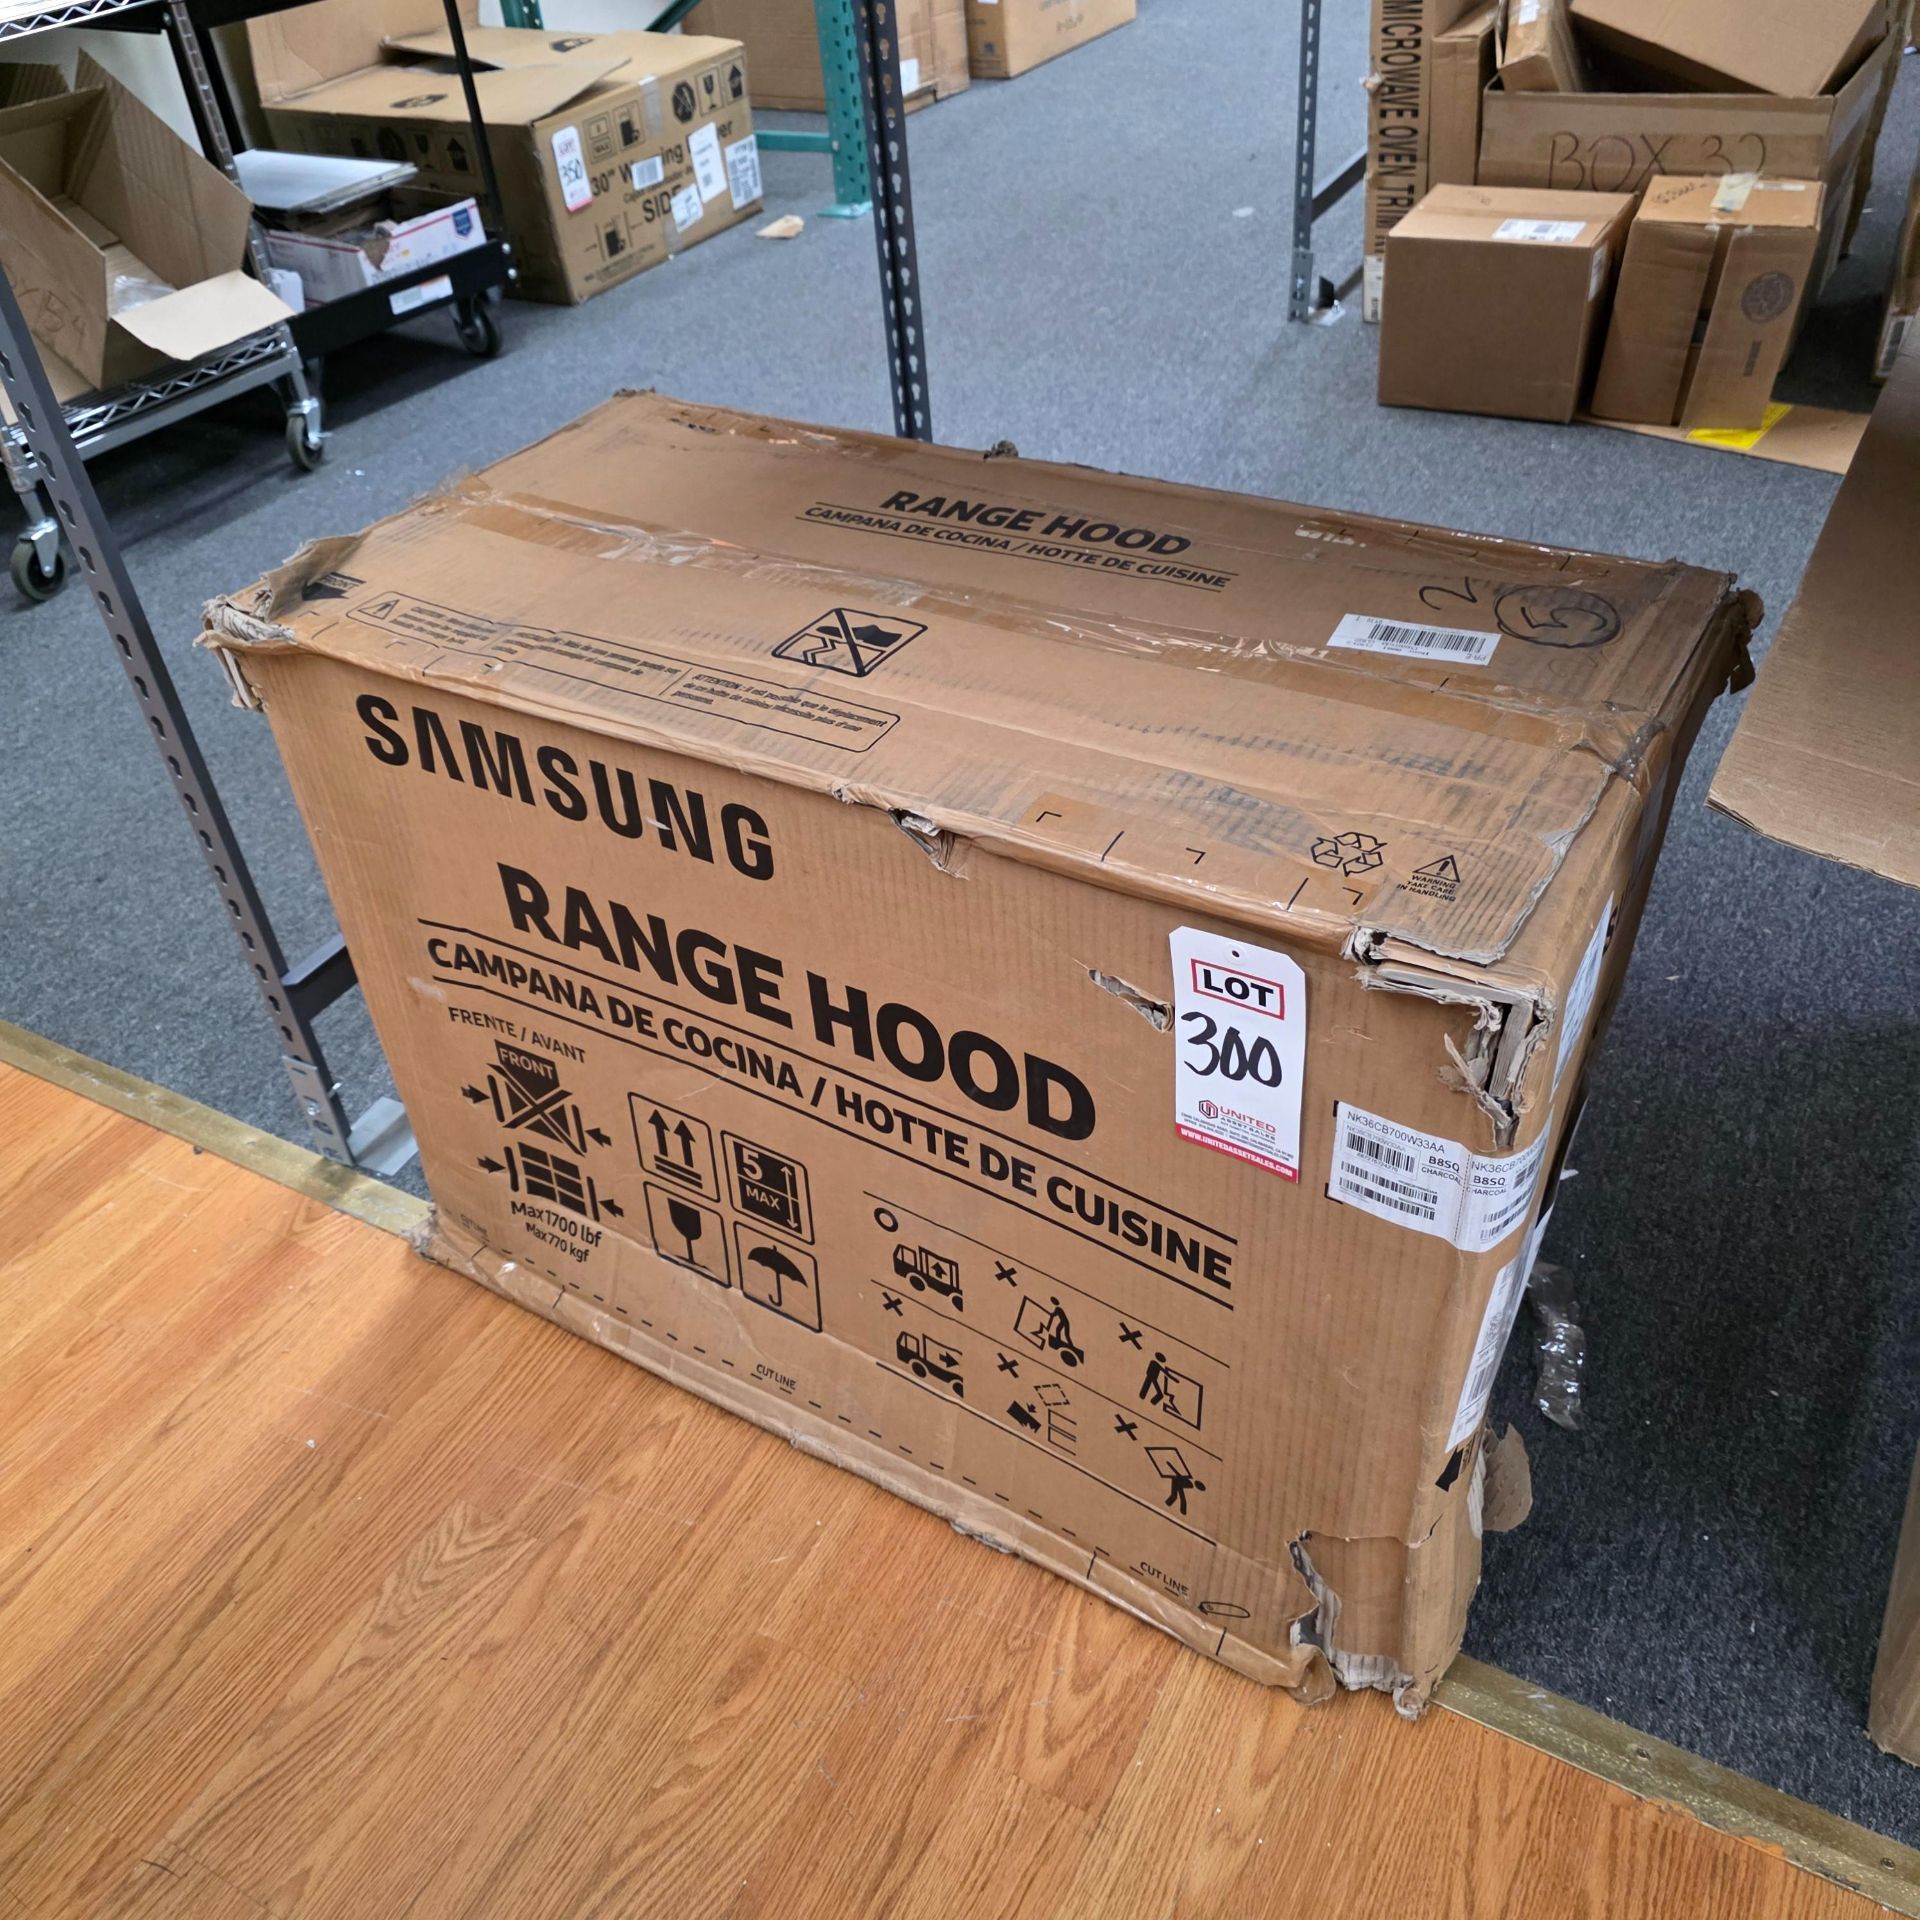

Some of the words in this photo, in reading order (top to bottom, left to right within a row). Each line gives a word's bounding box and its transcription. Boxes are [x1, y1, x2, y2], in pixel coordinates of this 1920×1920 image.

[1380, 0, 1423, 118] MICROWAVE
[1378, 125, 1418, 177] OVEN
[1547, 130, 1673, 193] BOX
[591, 168, 615, 197] 30"
[879, 490, 1045, 532] RANGE
[1040, 515, 1192, 556] HOOD
[804, 507, 901, 532] CAMPANA
[902, 524, 934, 536] DE
[934, 529, 1010, 552] COCINA
[1011, 542, 1025, 553] /
[1026, 544, 1098, 566] HOTTE
[1103, 557, 1134, 572] DE
[1136, 564, 1231, 589] CUISINE
[692, 674, 743, 690] ATTENTION
[356, 694, 775, 881] SAMSUNG
[1407, 881, 1429, 889] TAKE
[1430, 885, 1456, 895] CARE
[1408, 887, 1457, 902] HANDLING
[1411, 875, 1457, 889] WARNING
[497, 861, 793, 1029] RANGE
[806, 970, 1097, 1141] HOOD
[1203, 968, 1274, 1007] LOT
[448, 1006, 517, 1038] FRENTE
[520, 1026, 527, 1042] /
[531, 1032, 586, 1064] AVANT
[1180, 1011, 1282, 1088] 300
[499, 1048, 554, 1081] FRONT
[427, 937, 602, 1020] CAMPANA
[608, 995, 658, 1040] DE
[663, 1017, 805, 1098] COCINA
[810, 1077, 827, 1108] /
[836, 1085, 970, 1168] HOTTE
[980, 1143, 1037, 1197] DE
[1047, 1176, 1232, 1290] CUISINE
[1220, 1105, 1277, 1133] UNITED
[1220, 1117, 1248, 1129] ASSET
[1248, 1126, 1276, 1140] SALES
[1347, 1111, 1446, 1154] NK36CB700W33AA
[742, 1146, 763, 1180] 5
[1421, 1166, 1462, 1186] CHARCOAL
[1428, 1155, 1460, 1173] B8SQ
[1466, 1186, 1507, 1196] CHARCOAL
[1473, 1175, 1506, 1186] B8SQ
[745, 1184, 780, 1210] MAX
[568, 1240, 590, 1262] kgf
[579, 1226, 603, 1248] lbf
[756, 1363, 775, 1379] CUT
[774, 1374, 797, 1390] LINE
[1140, 1561, 1161, 1579] CUT
[1162, 1573, 1190, 1596] LINE
